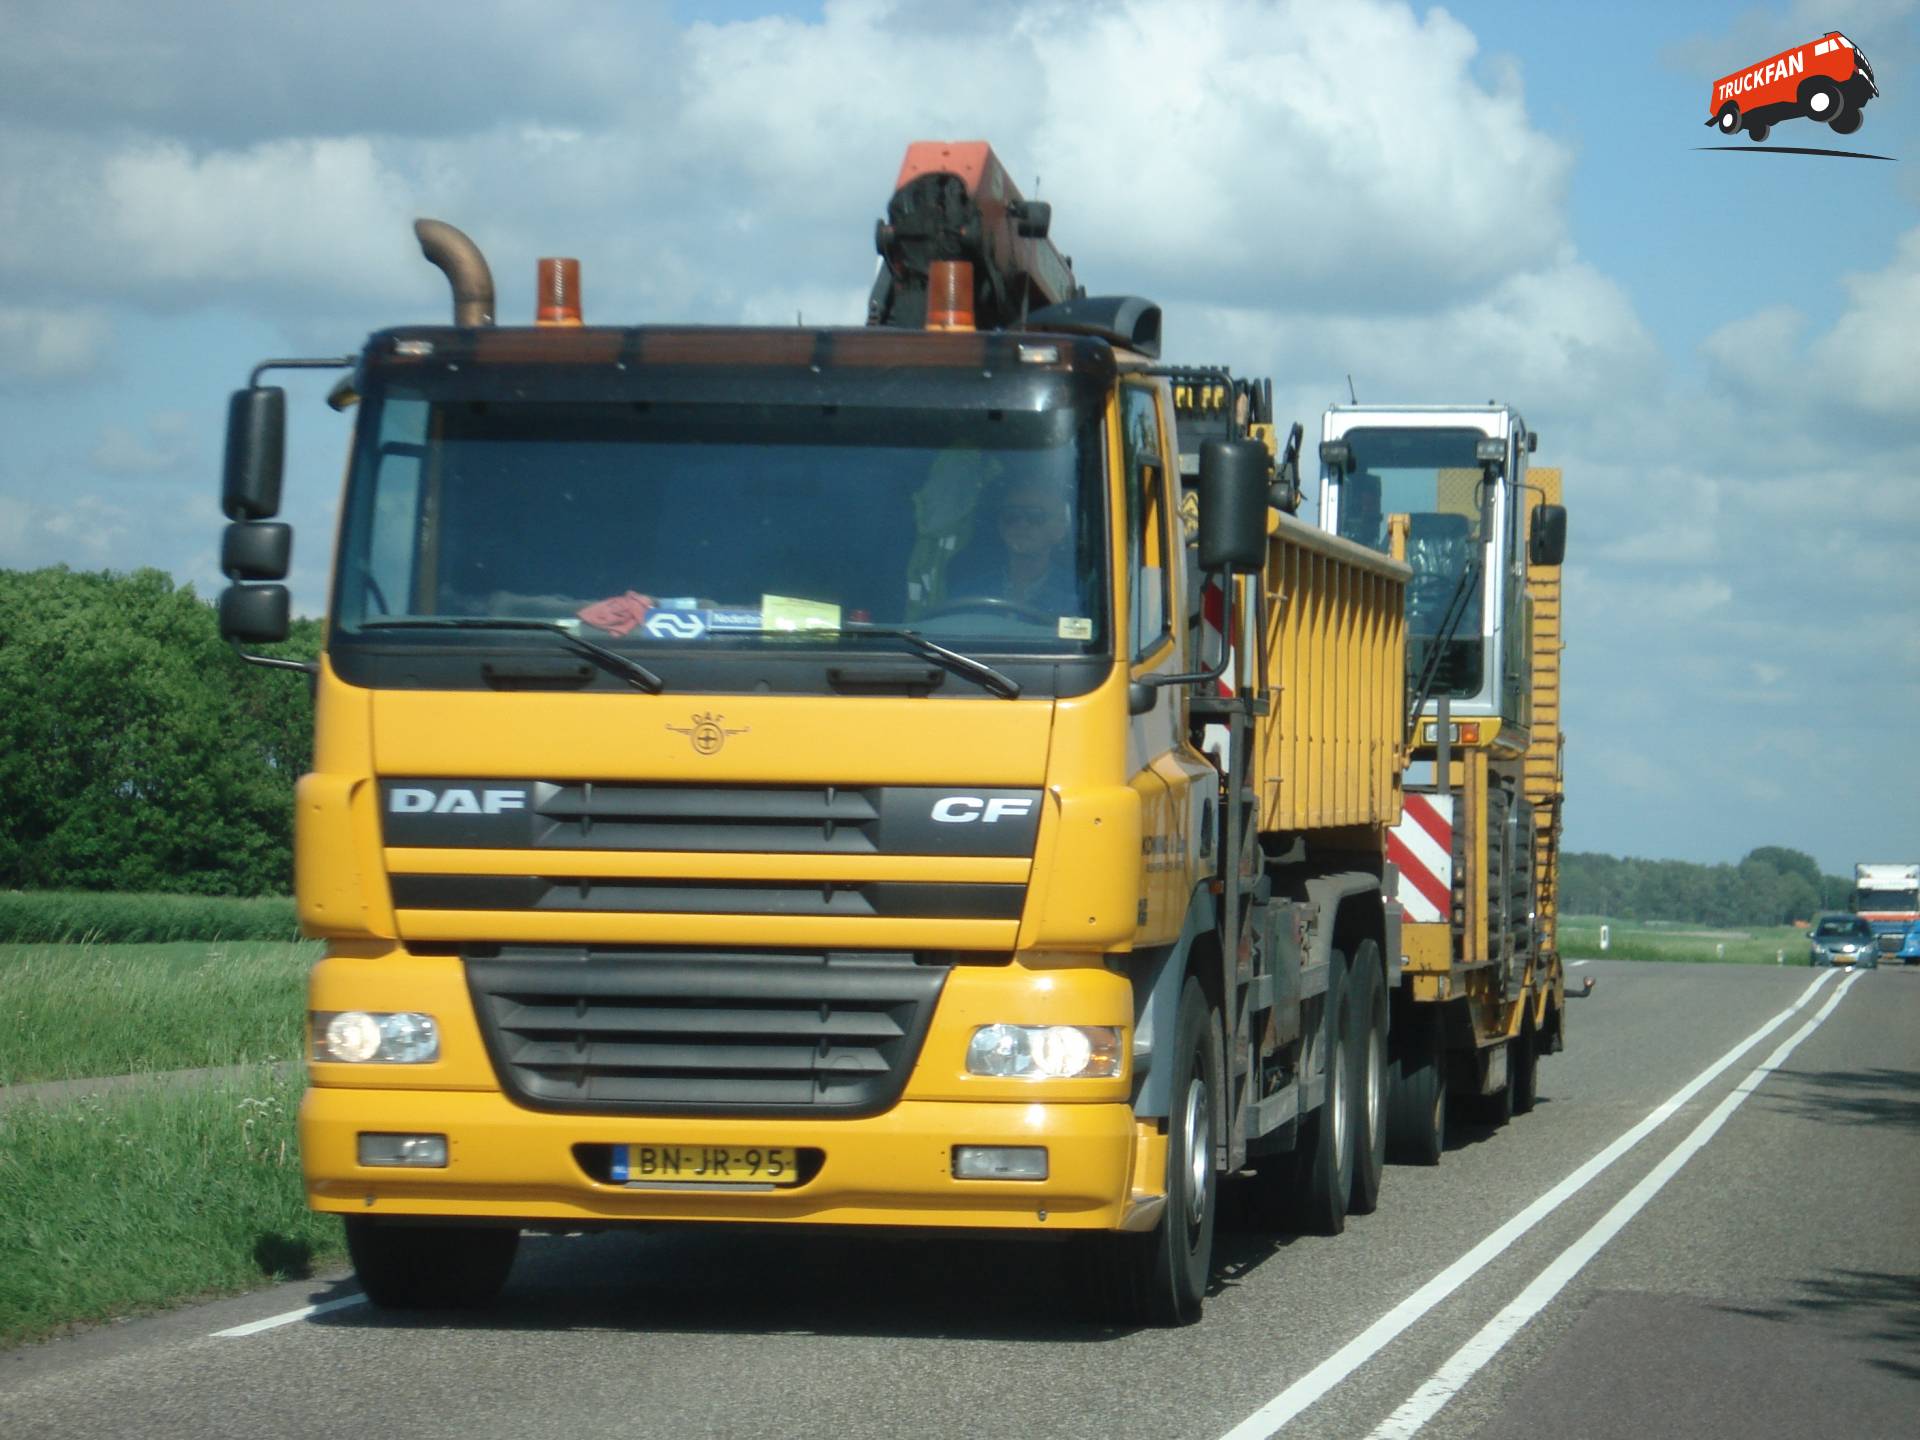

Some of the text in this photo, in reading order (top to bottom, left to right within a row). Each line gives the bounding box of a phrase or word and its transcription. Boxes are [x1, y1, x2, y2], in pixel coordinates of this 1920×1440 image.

[390, 788, 526, 814] DAF
[931, 796, 1033, 823] CF
[640, 1148, 784, 1176] BN-JR-95
